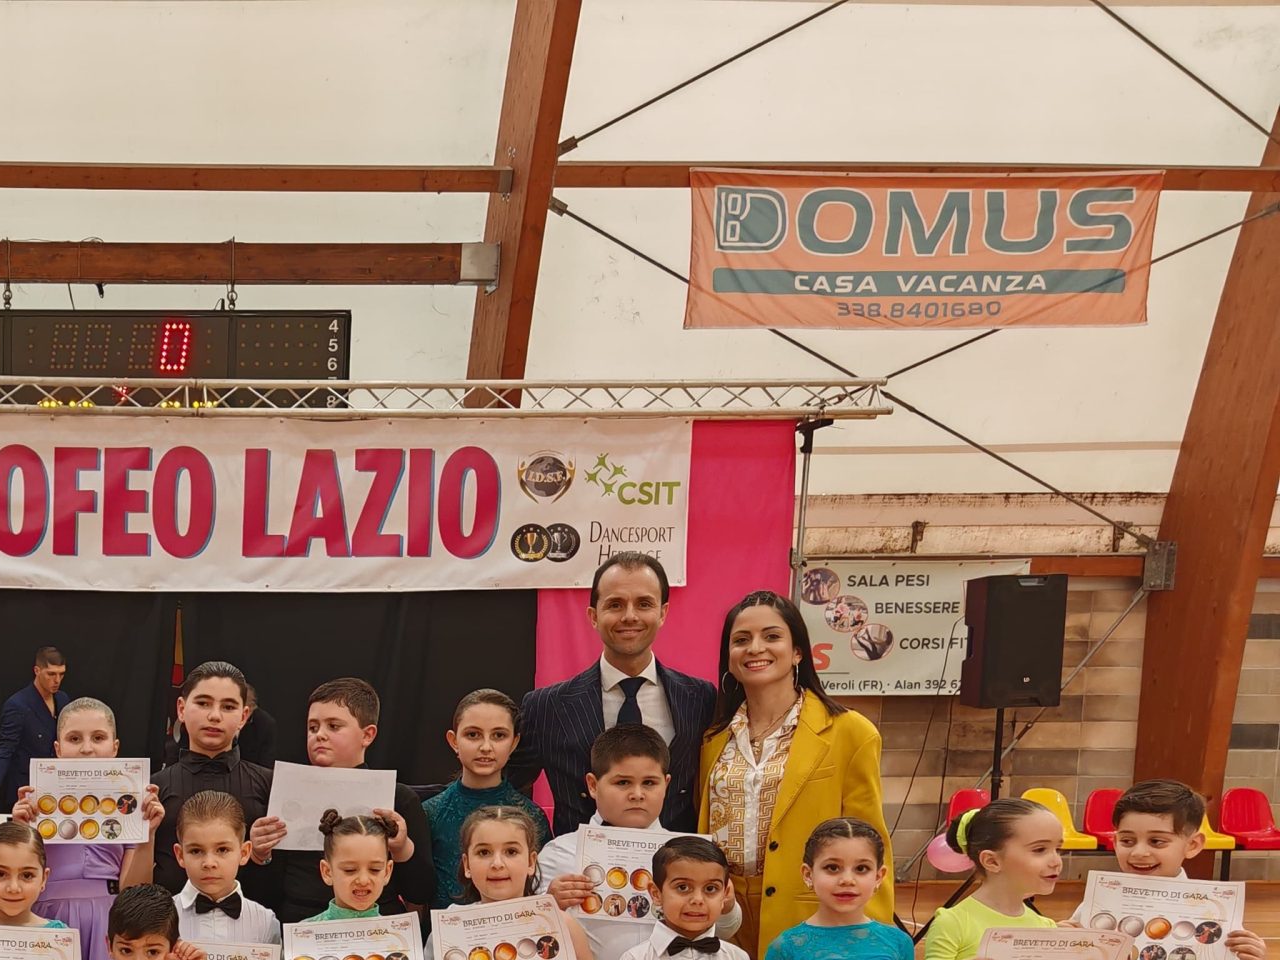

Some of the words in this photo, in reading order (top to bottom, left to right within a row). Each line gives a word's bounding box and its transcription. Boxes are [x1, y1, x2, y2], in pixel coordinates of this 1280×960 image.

[715, 186, 1136, 257] DOMUS
[794, 274, 878, 293] CASA
[896, 274, 1047, 293] VACANZA
[837, 300, 1002, 318] 338.8401680
[328, 319, 339, 333] 4
[161, 323, 191, 371] 0
[328, 338, 339, 352] 5
[328, 357, 338, 371] 6
[618, 481, 681, 505] CSIT
[242, 446, 502, 560] LAZIO
[847, 574, 890, 587] SALA
[895, 574, 930, 587] PESI
[875, 601, 960, 614] BENESSERE
[900, 638, 944, 650] CORSI
[950, 638, 968, 650] FI
[821, 680, 854, 690] Veroli
[858, 680, 883, 691] (FR)
[894, 680, 920, 690] Alan
[925, 679, 946, 689] 392
[1122, 886, 1168, 898] BREVETTO
[1170, 891, 1181, 899] DI
[462, 915, 503, 928] BREVETTO
[504, 913, 513, 921] DI
[315, 930, 355, 941] BREVETTO
[356, 930, 365, 938] DI
[1013, 938, 1057, 947] BREVETTO
[1058, 939, 1068, 947] DI
[18, 940, 28, 948] DI
